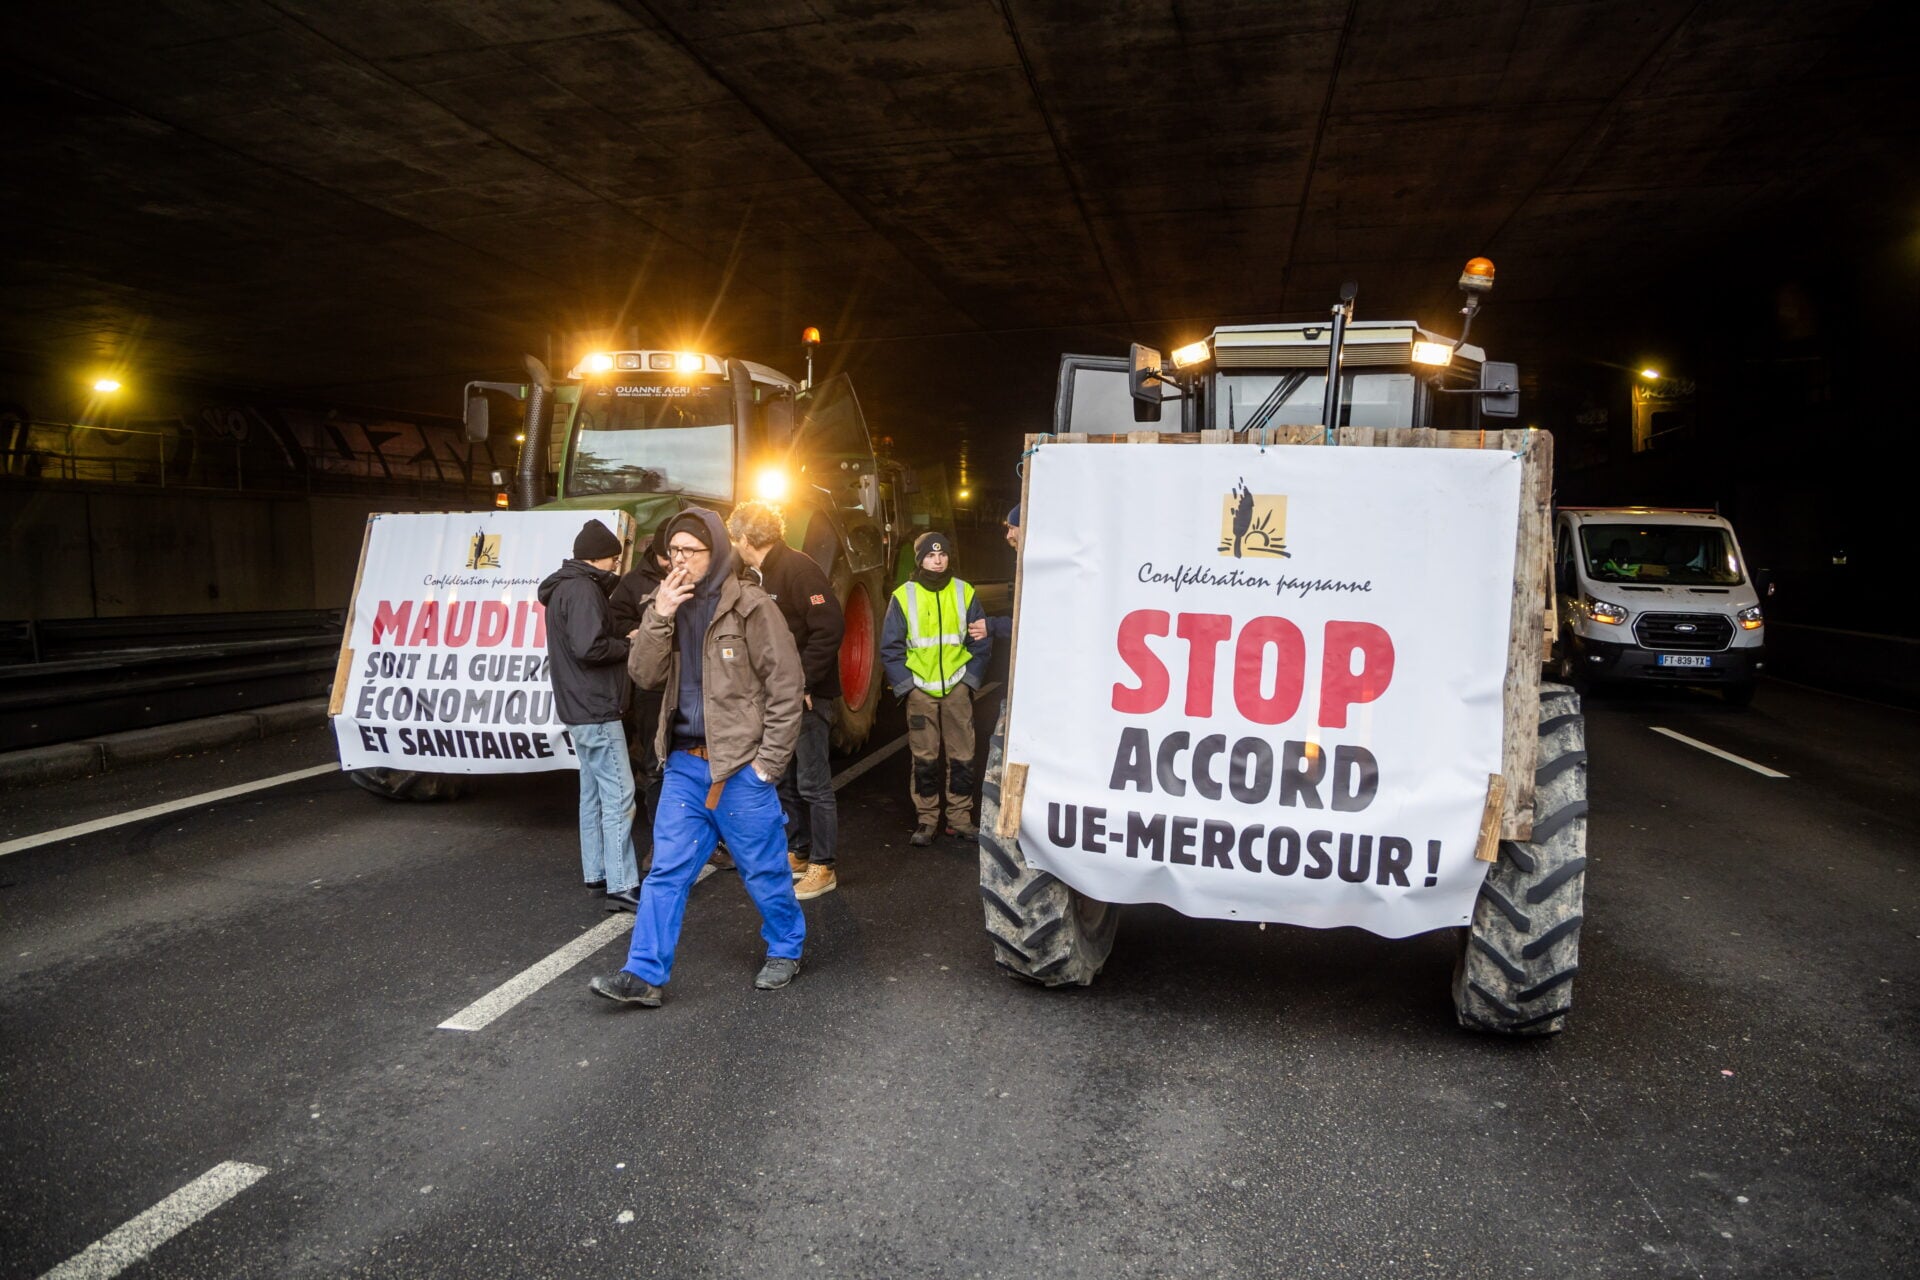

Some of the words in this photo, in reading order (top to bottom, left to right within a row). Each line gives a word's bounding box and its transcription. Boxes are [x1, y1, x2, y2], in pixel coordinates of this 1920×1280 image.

[664, 386, 690, 394] AGRI
[423, 574, 490, 586] Confédération
[490, 576, 540, 588] paysanne
[1137, 562, 1271, 593] Confédération
[1275, 573, 1372, 597] paysanne
[371, 600, 549, 648] MAUDIT
[364, 651, 421, 679] SOIT
[426, 653, 458, 681] LA
[468, 654, 551, 683] GUER
[1111, 608, 1395, 729] STOP
[359, 726, 389, 753] ET
[398, 727, 555, 760] SANITAIRE
[1108, 727, 1380, 813] ACCORD
